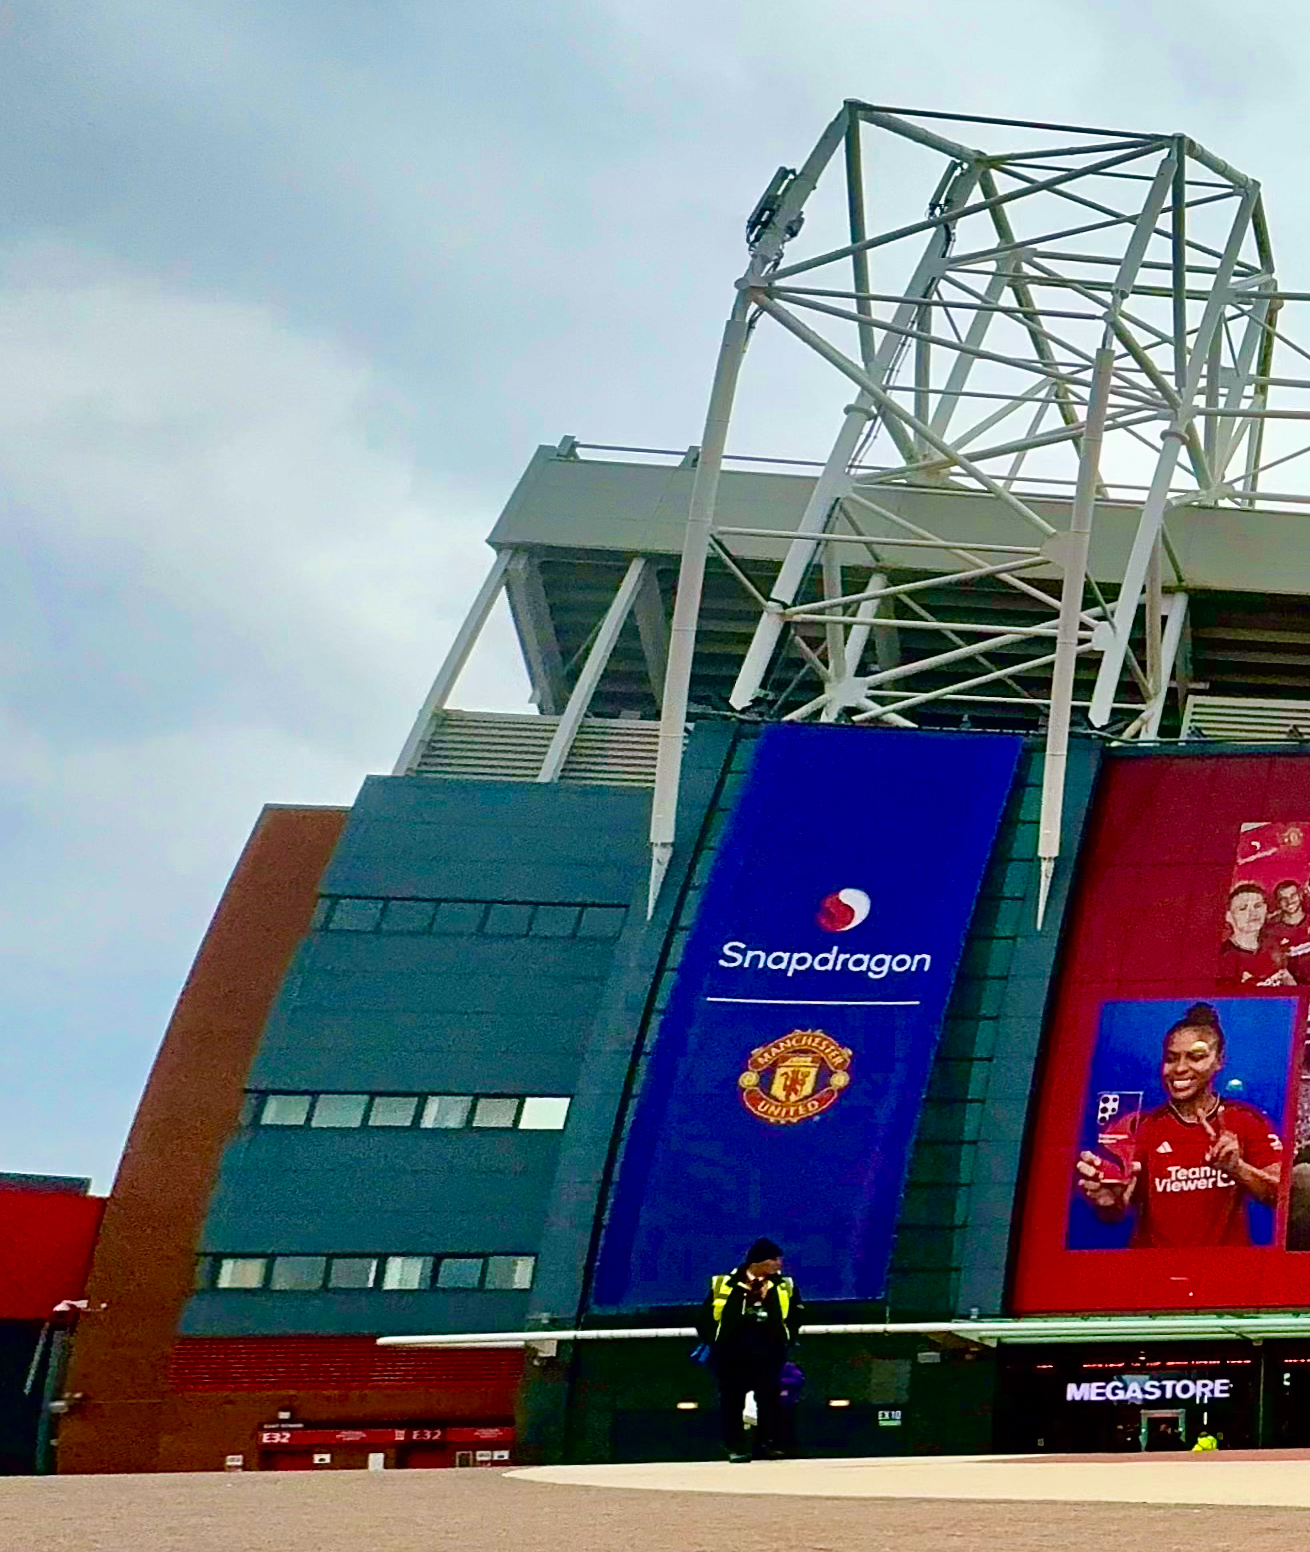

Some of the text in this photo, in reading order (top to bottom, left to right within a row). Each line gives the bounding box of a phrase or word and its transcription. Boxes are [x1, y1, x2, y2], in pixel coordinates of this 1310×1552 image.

[718, 941, 931, 979] Snapdragon
[757, 1036, 845, 1066] MANCHESTER
[757, 1099, 820, 1117] UNITED
[1155, 1177, 1216, 1192] Viewer
[1066, 1379, 1231, 1402] MEGASTORE
[262, 1432, 291, 1443] E32
[412, 1429, 441, 1440] E32
